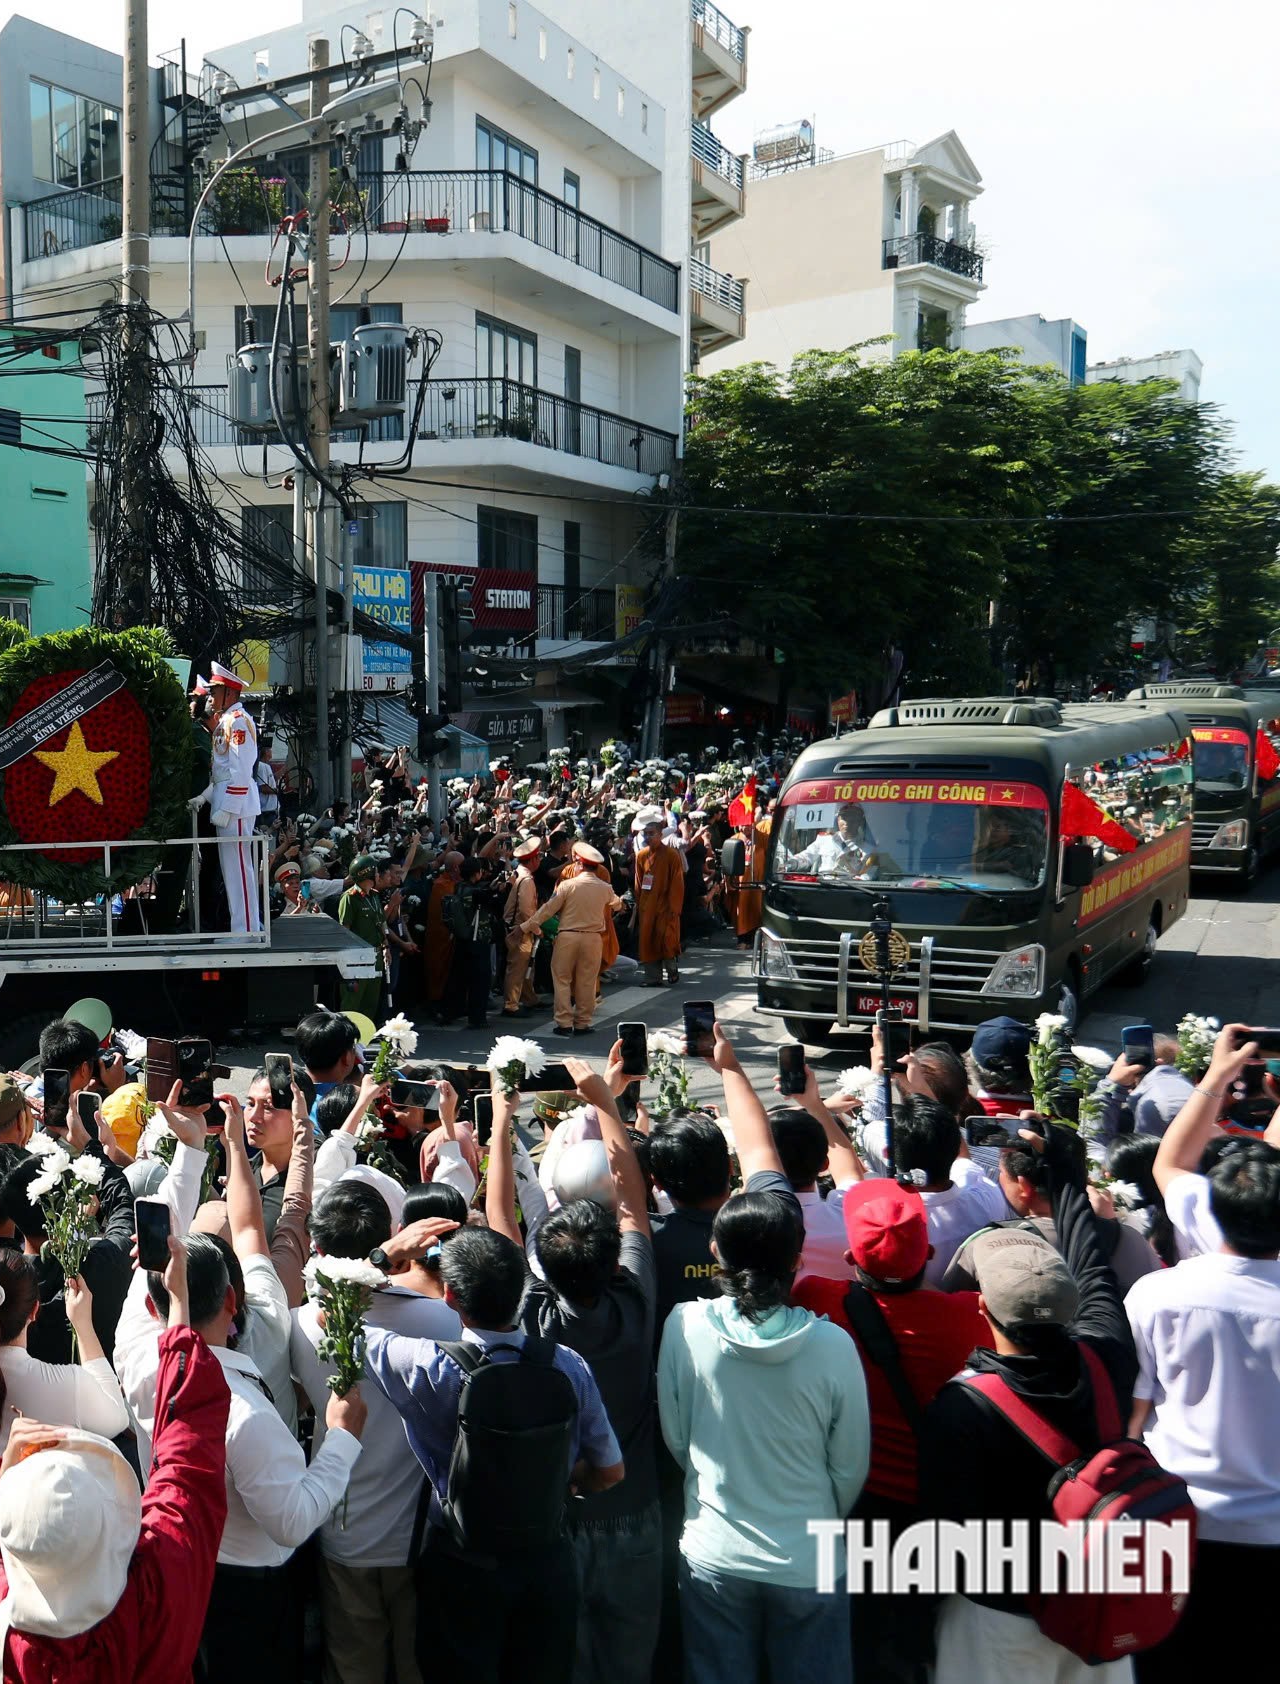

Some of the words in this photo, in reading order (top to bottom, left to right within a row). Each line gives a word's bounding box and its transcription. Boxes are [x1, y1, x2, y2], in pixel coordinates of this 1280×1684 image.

[384, 572, 406, 599] HÀ
[486, 588, 531, 609] STATION
[394, 605, 411, 626] XE
[386, 676, 396, 690] XE
[32, 724, 57, 742] KÍNH
[55, 704, 85, 726] VIẾNG
[507, 719, 518, 735] XE
[834, 780, 855, 800] TỔ
[857, 780, 901, 801] QUỐC
[905, 785, 934, 800] GHI
[938, 783, 986, 801] CÔNG
[806, 809, 824, 823] 01
